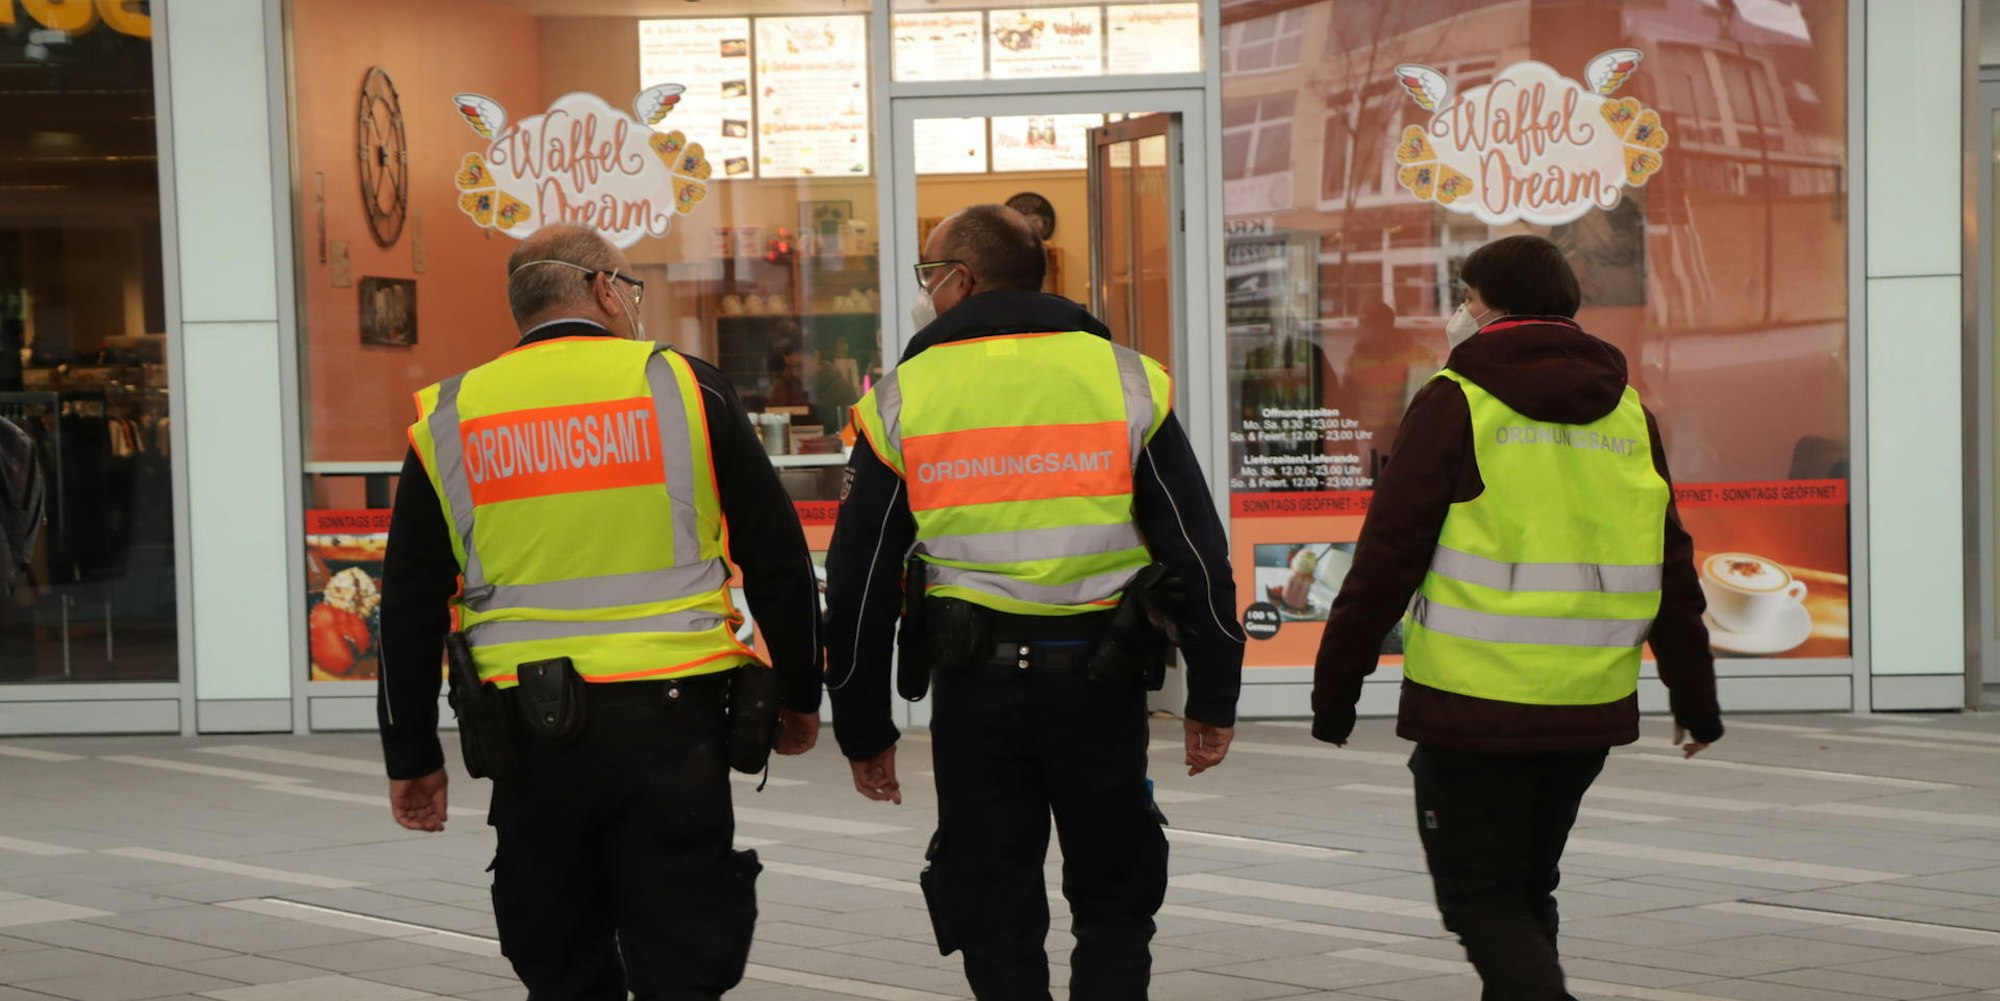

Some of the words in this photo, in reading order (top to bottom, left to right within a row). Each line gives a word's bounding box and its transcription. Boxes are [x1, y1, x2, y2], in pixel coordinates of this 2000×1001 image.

[1431, 79, 1595, 165] Waffel
[490, 109, 644, 193] Waffel
[1480, 148, 1620, 214] Dream
[536, 176, 669, 236] Dream
[1243, 420, 1261, 430] Mo.
[1263, 420, 1280, 430] Sa.
[1281, 419, 1304, 430] 9.30
[1341, 418, 1359, 429] Uhr
[1230, 431, 1245, 441] So.
[1291, 430, 1318, 441] 12.00
[1355, 430, 1373, 440] Uhr
[1496, 426, 1636, 457] ORDNUNGSAMT
[466, 409, 651, 484] ORDNUNGSAMT
[917, 450, 1113, 484] ORDNUNGSAMT
[1243, 454, 1359, 465] Lieferzeiten/Lieferando
[1241, 466, 1259, 476] Mo.
[1261, 466, 1277, 476] Sa.
[1281, 465, 1307, 476] 12.00
[1315, 464, 1343, 476] 23.00
[1345, 465, 1363, 475] Uhr
[1230, 478, 1246, 488] So.
[1292, 477, 1318, 488] 12.00
[1326, 476, 1353, 488] 23.00
[1355, 476, 1374, 487] Uhr
[1722, 486, 1779, 502] SONNTAGS
[1781, 484, 1837, 499] GEÖFFNET
[1242, 498, 1297, 512] SONNTAGS
[1298, 496, 1351, 511] GEÖFFNET
[318, 515, 369, 528] SONNTAGS
[1247, 611, 1265, 620] 100
[1267, 611, 1277, 620] %
[1246, 621, 1277, 631] Genuss
